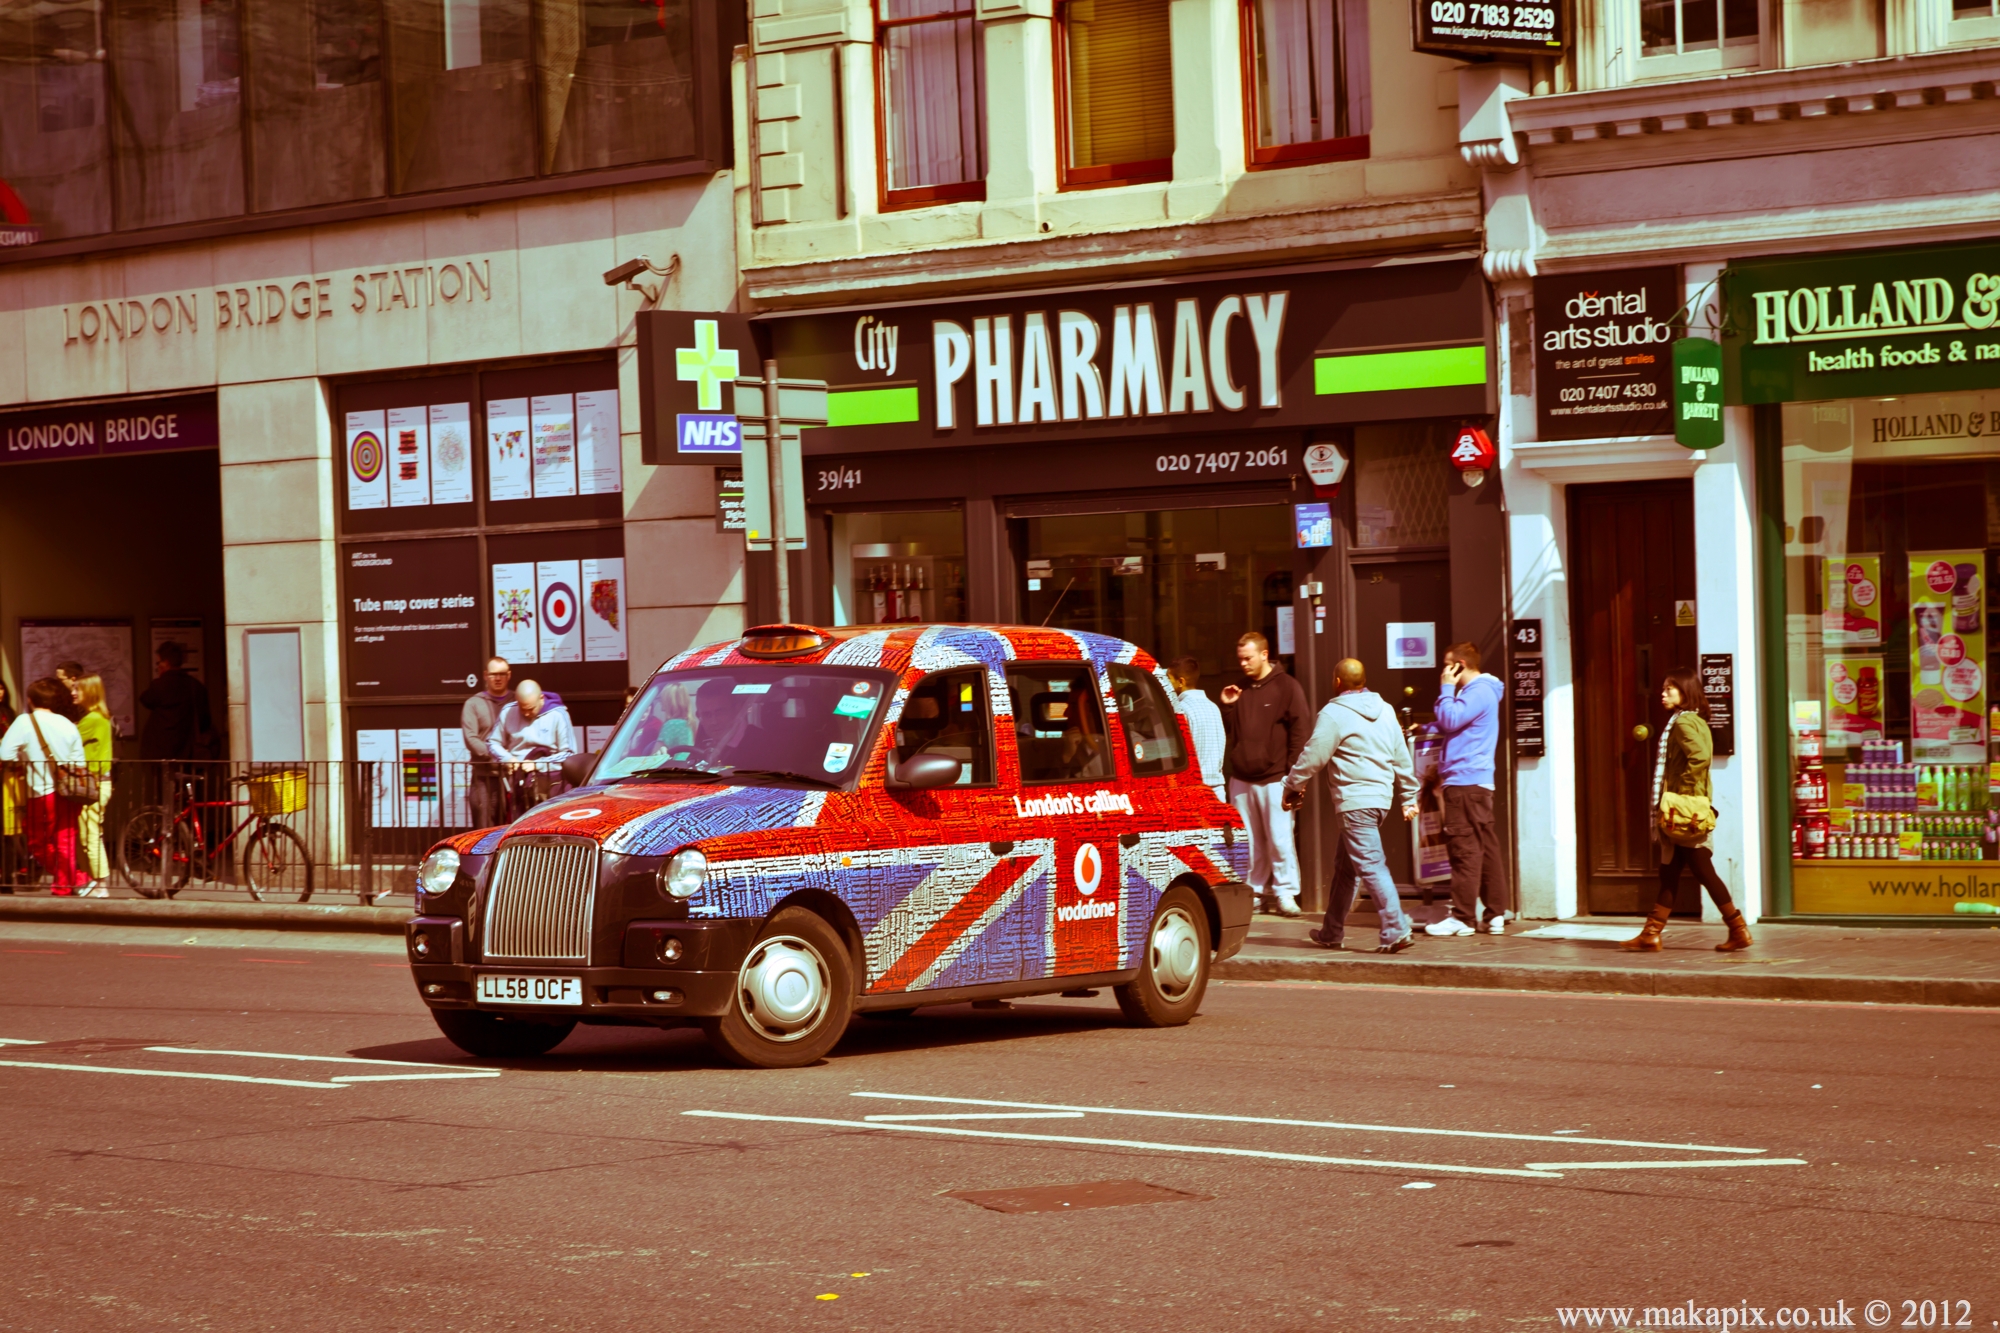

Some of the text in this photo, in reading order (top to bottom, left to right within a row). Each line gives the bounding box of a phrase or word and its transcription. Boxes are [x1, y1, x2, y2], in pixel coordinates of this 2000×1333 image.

[1431, 1, 1555, 29] 020 7183 2529
[1432, 25, 1554, 41] www.kingsbury-consultants.co.uk
[62, 259, 491, 346] LONDON BRIDGE STATION
[1565, 287, 1646, 319] dental
[1752, 273, 2000, 345] HOLLAND &
[854, 316, 898, 376] City
[1808, 347, 1874, 372] health
[1880, 343, 1941, 366] foods
[1948, 340, 1968, 362] &
[932, 290, 1290, 430] PHARMACY
[1555, 354, 1655, 370] the art of great smiles
[1681, 366, 1719, 386] HOLLAND
[1560, 383, 1657, 402] 020 7407 4330
[1696, 383, 1706, 401] &
[1550, 400, 1668, 416] www.dentalartsstudio.co.uk
[1682, 402, 1719, 421] BARRETT
[8, 414, 179, 451] LONDON BRIDGE
[683, 420, 738, 446] NHS
[1871, 413, 1963, 443] HOLLAND
[1967, 411, 1985, 438] &
[1156, 446, 1288, 474] 020 7407 2061
[818, 465, 861, 491] 39/41
[720, 500, 739, 509] Same
[353, 594, 475, 613] Tube map cover series
[754, 636, 798, 650] TAXI
[1517, 628, 1537, 643] 43
[1702, 666, 1731, 676] dental
[1708, 675, 1725, 684] arts
[1704, 683, 1731, 694] studio
[1013, 792, 1084, 818] London's
[1084, 790, 1134, 815] calling
[637, 817, 676, 845] Tottenham
[756, 844, 802, 856] Holland Park
[721, 888, 730, 917] berry
[1057, 899, 1116, 921] vodafone
[484, 977, 573, 1000] LL58 OCF
